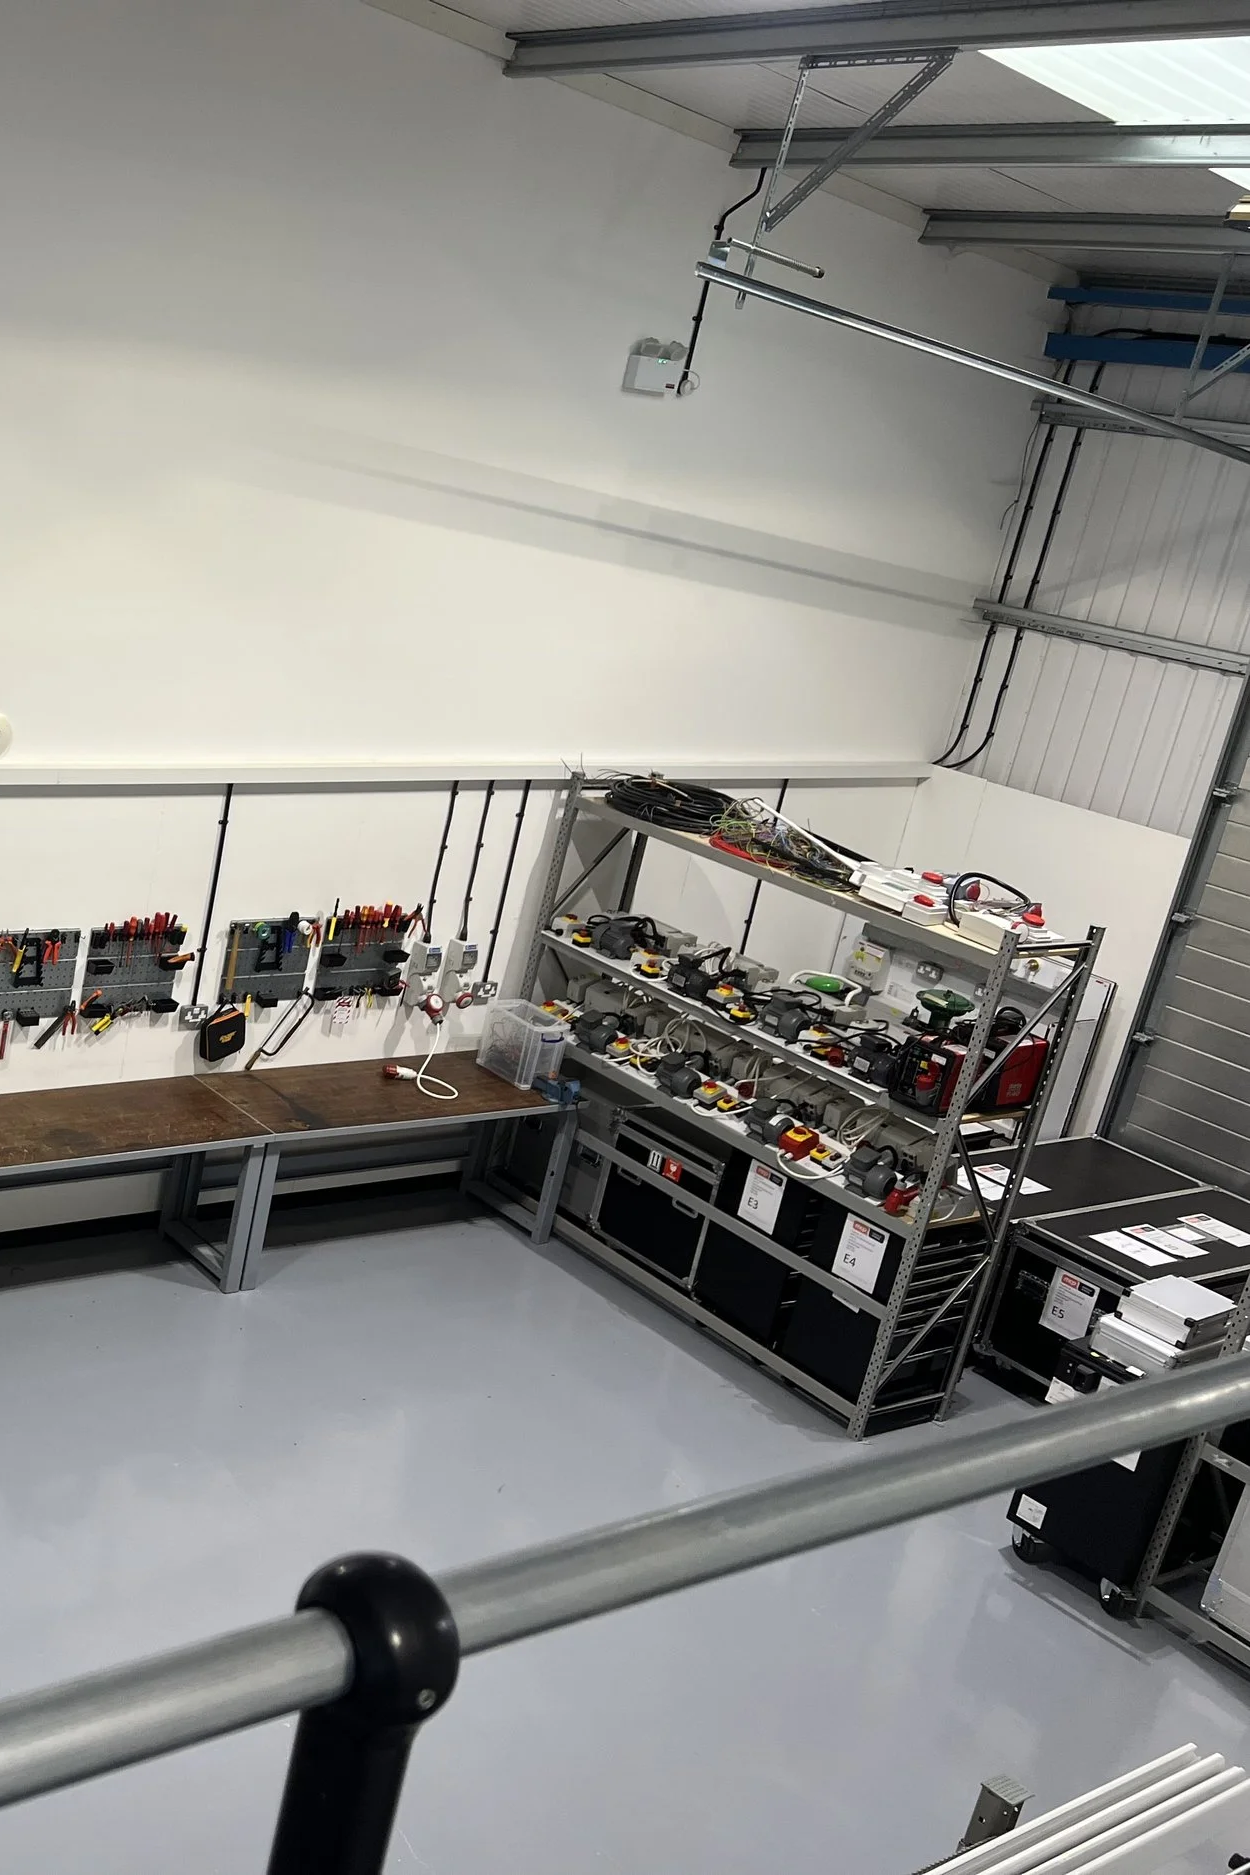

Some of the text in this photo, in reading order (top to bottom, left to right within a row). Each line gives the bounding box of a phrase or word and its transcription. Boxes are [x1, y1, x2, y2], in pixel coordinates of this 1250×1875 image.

[747, 1196, 759, 1210] E3
[843, 1253, 857, 1267] E4
[1051, 1305, 1065, 1319] E5
